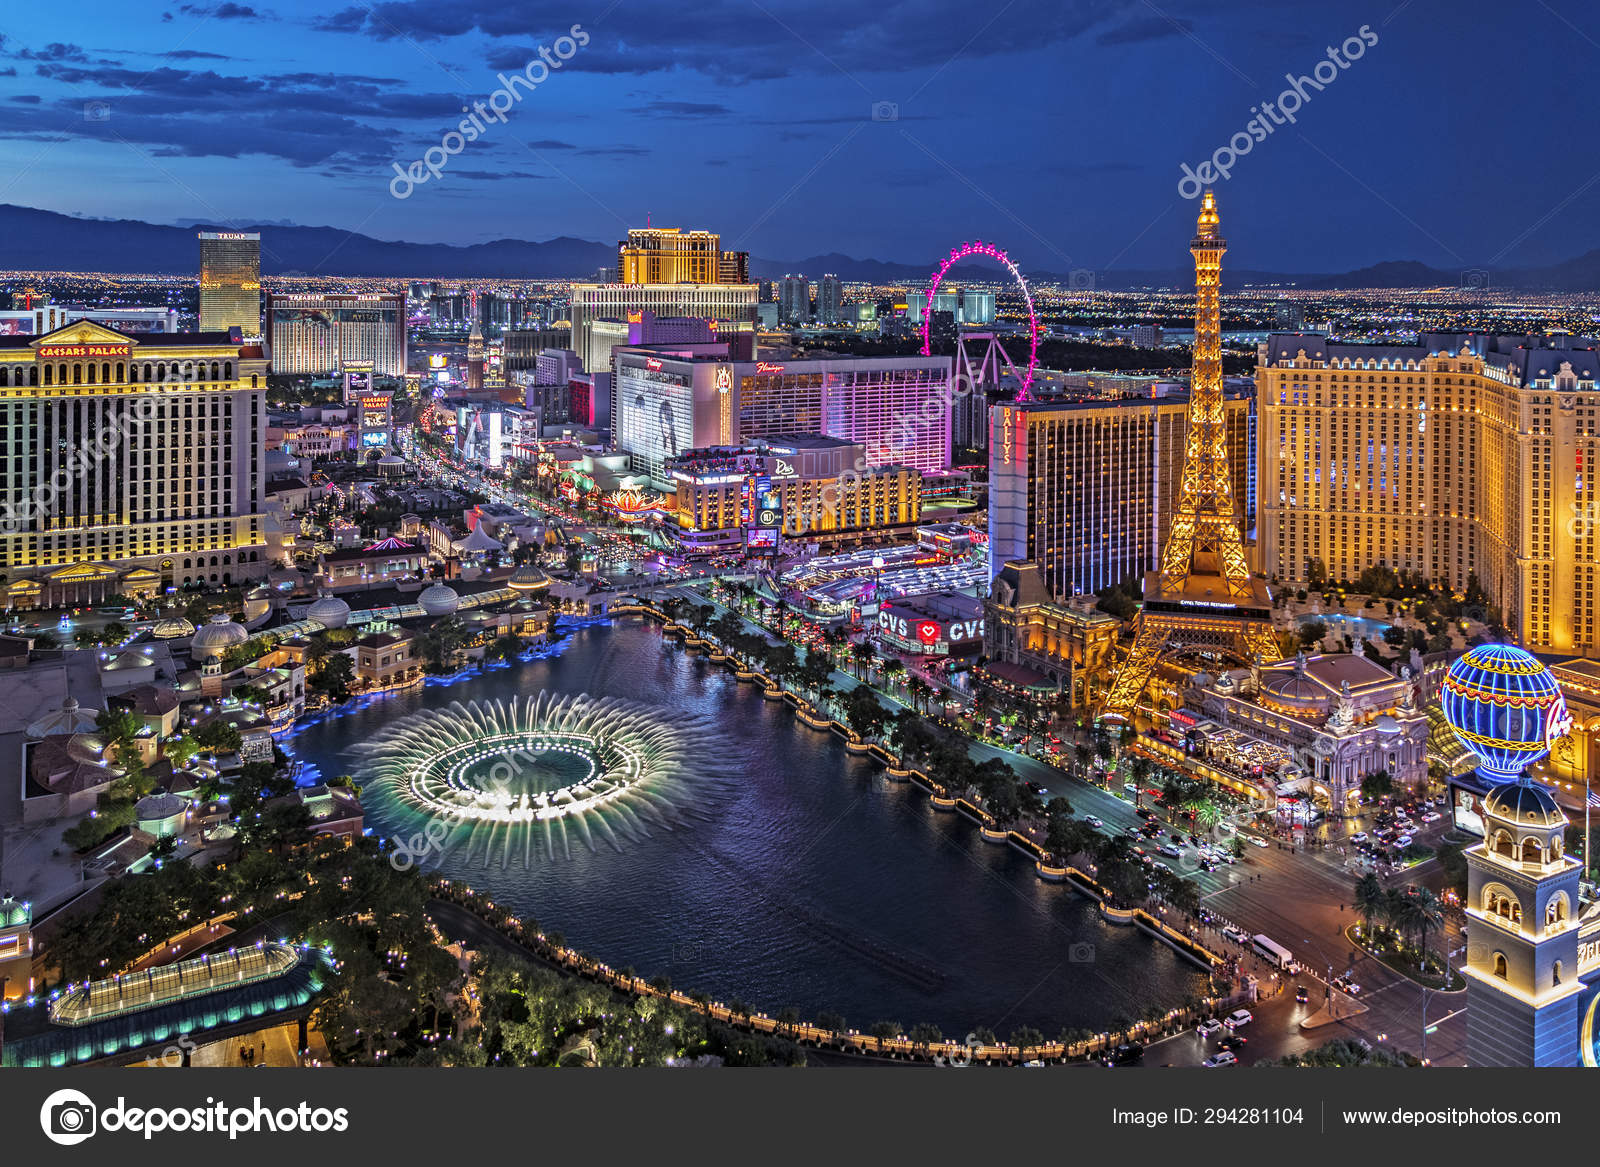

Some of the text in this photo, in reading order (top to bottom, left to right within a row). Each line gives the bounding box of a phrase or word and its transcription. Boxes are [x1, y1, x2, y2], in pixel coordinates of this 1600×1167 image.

[40, 346, 129, 356] CAESARS PALACE
[879, 610, 908, 636] CVS
